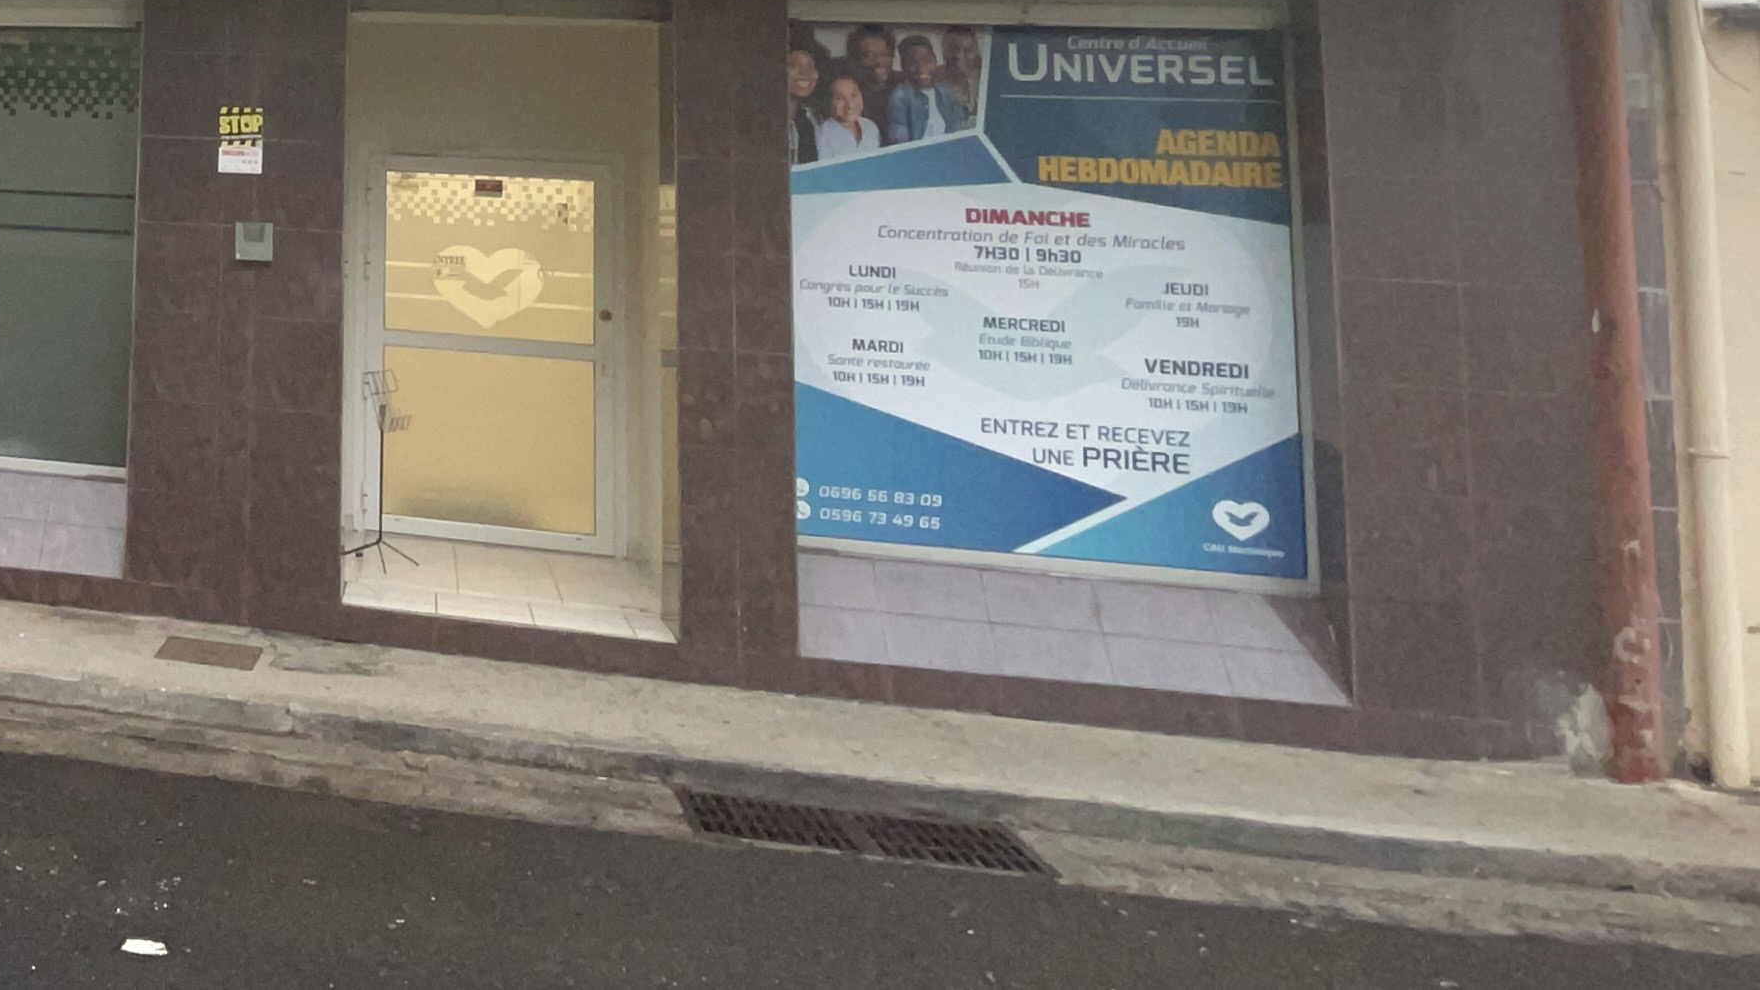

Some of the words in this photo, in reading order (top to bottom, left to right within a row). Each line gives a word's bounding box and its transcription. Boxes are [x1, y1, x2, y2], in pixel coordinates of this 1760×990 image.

[1067, 35, 1124, 50] Centre
[1008, 43, 1274, 85] UNIVERSEL
[219, 114, 263, 134] STOP
[1156, 129, 1281, 157] AGENDA
[1038, 156, 1282, 188] HEBDOMADAIRE
[965, 208, 1090, 227] DIMANCHE
[878, 225, 992, 242] Concentration
[999, 230, 1018, 243] de
[1054, 234, 1070, 246] et
[1078, 233, 1107, 248] des
[1112, 235, 1185, 250] Miracles
[973, 245, 1019, 260] 7H30
[1036, 247, 1081, 263] 9h30
[849, 264, 896, 279] LUNDI
[1005, 263, 1020, 275] de
[1023, 264, 1035, 276] la
[855, 284, 885, 295] pour
[888, 284, 901, 294] le
[1018, 278, 1039, 289] 15H
[1164, 282, 1208, 296] JEUDI
[828, 296, 850, 308] 10H
[862, 298, 884, 310] 15H
[896, 300, 920, 312] 19H
[1125, 297, 1175, 311] Famille
[1178, 301, 1191, 312] et
[1196, 301, 1250, 317] Mariage
[983, 316, 1065, 333] MERCREDI
[1176, 316, 1200, 328] 19H
[852, 338, 904, 353] MARDI
[1020, 335, 1072, 351] Biblique
[978, 349, 1002, 361] 10H
[1014, 351, 1037, 363] 15H
[1049, 353, 1073, 365] 19H
[1144, 357, 1250, 380] VENDREDI
[833, 371, 856, 383] 10H
[867, 373, 889, 385] 15H
[901, 375, 926, 387] 19H
[1201, 382, 1275, 399] Spirituelle
[1149, 397, 1173, 409] 10H
[1185, 399, 1209, 412] 15H
[1222, 401, 1248, 414] 19H
[980, 417, 1059, 439] ENTREZ
[1066, 423, 1090, 441] ET
[1097, 425, 1190, 448] RECEVEZ
[1032, 447, 1075, 467] UNE
[1082, 446, 1190, 475] PRIÈRE
[819, 485, 862, 500] 0696
[868, 489, 888, 503] 56
[894, 491, 915, 506] 83
[920, 493, 943, 507] 09
[819, 507, 863, 523] 0596
[869, 511, 887, 525] 73
[892, 514, 914, 528] 49
[919, 516, 941, 530] 65
